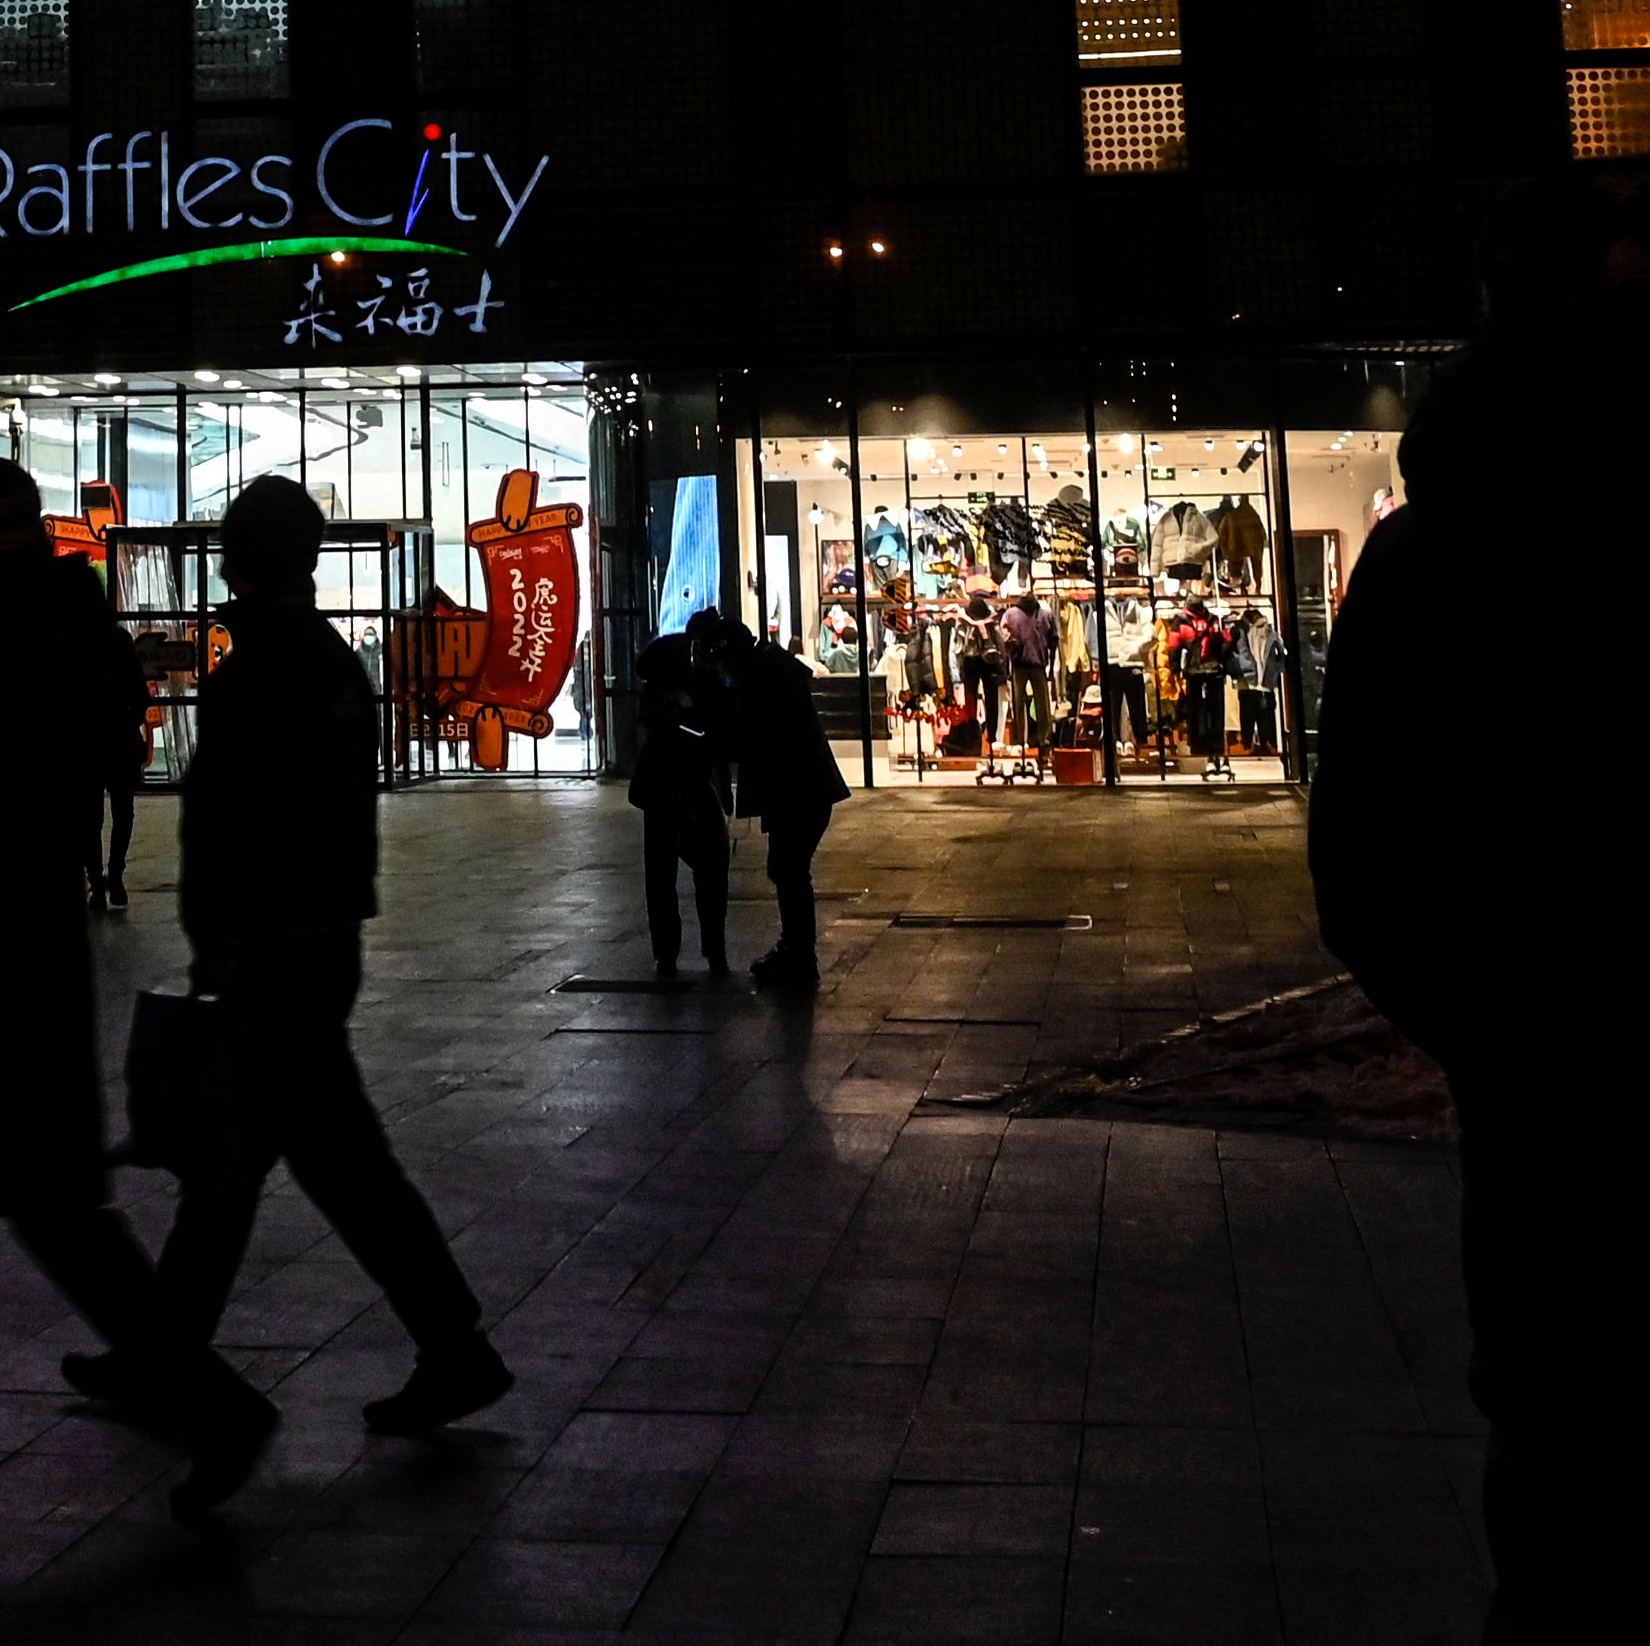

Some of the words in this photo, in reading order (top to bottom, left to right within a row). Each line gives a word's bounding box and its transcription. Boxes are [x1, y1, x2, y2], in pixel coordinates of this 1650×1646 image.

[315, 116, 551, 250] City
[282, 262, 506, 349] 来福士
[509, 568, 527, 658] 2022
